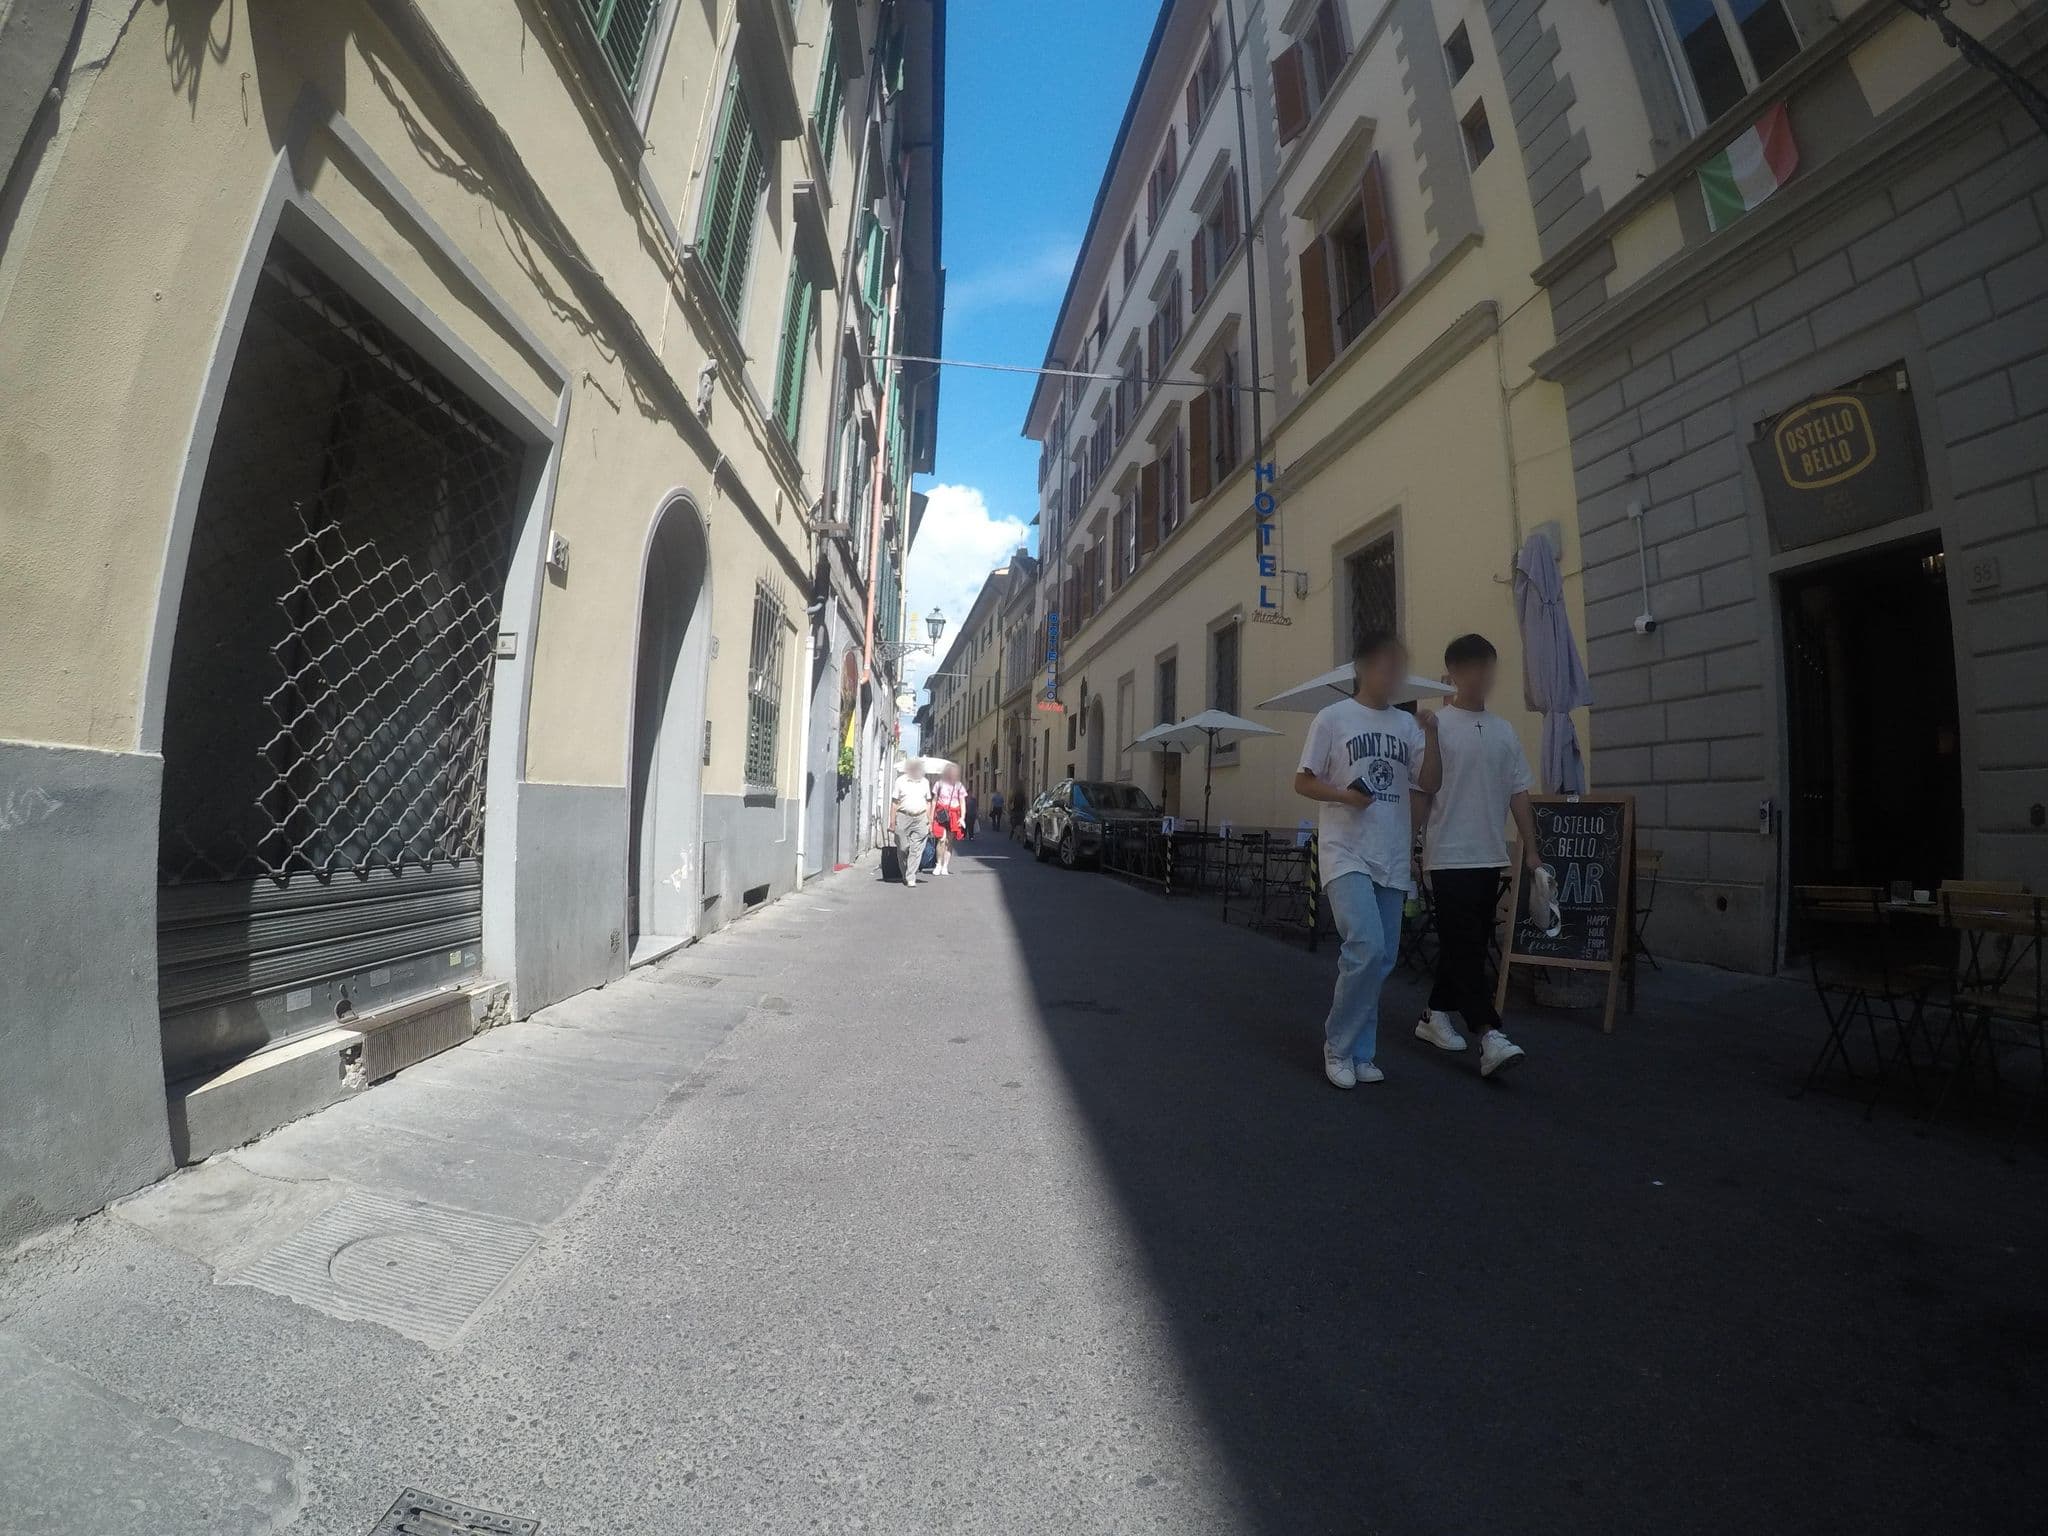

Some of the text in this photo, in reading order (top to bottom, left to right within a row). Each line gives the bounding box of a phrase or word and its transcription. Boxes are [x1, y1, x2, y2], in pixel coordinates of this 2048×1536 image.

[1786, 408, 1854, 453] OSTELLO
[1801, 439, 1852, 476] BELLO
[1254, 462, 1276, 609] HOTEL
[1346, 732, 1382, 766] TOMMY
[1388, 793, 1400, 804] CITY
[1552, 815, 1604, 834] OSTELLO
[1557, 837, 1596, 858] BELLO
[1586, 914, 1610, 927] HAPPY
